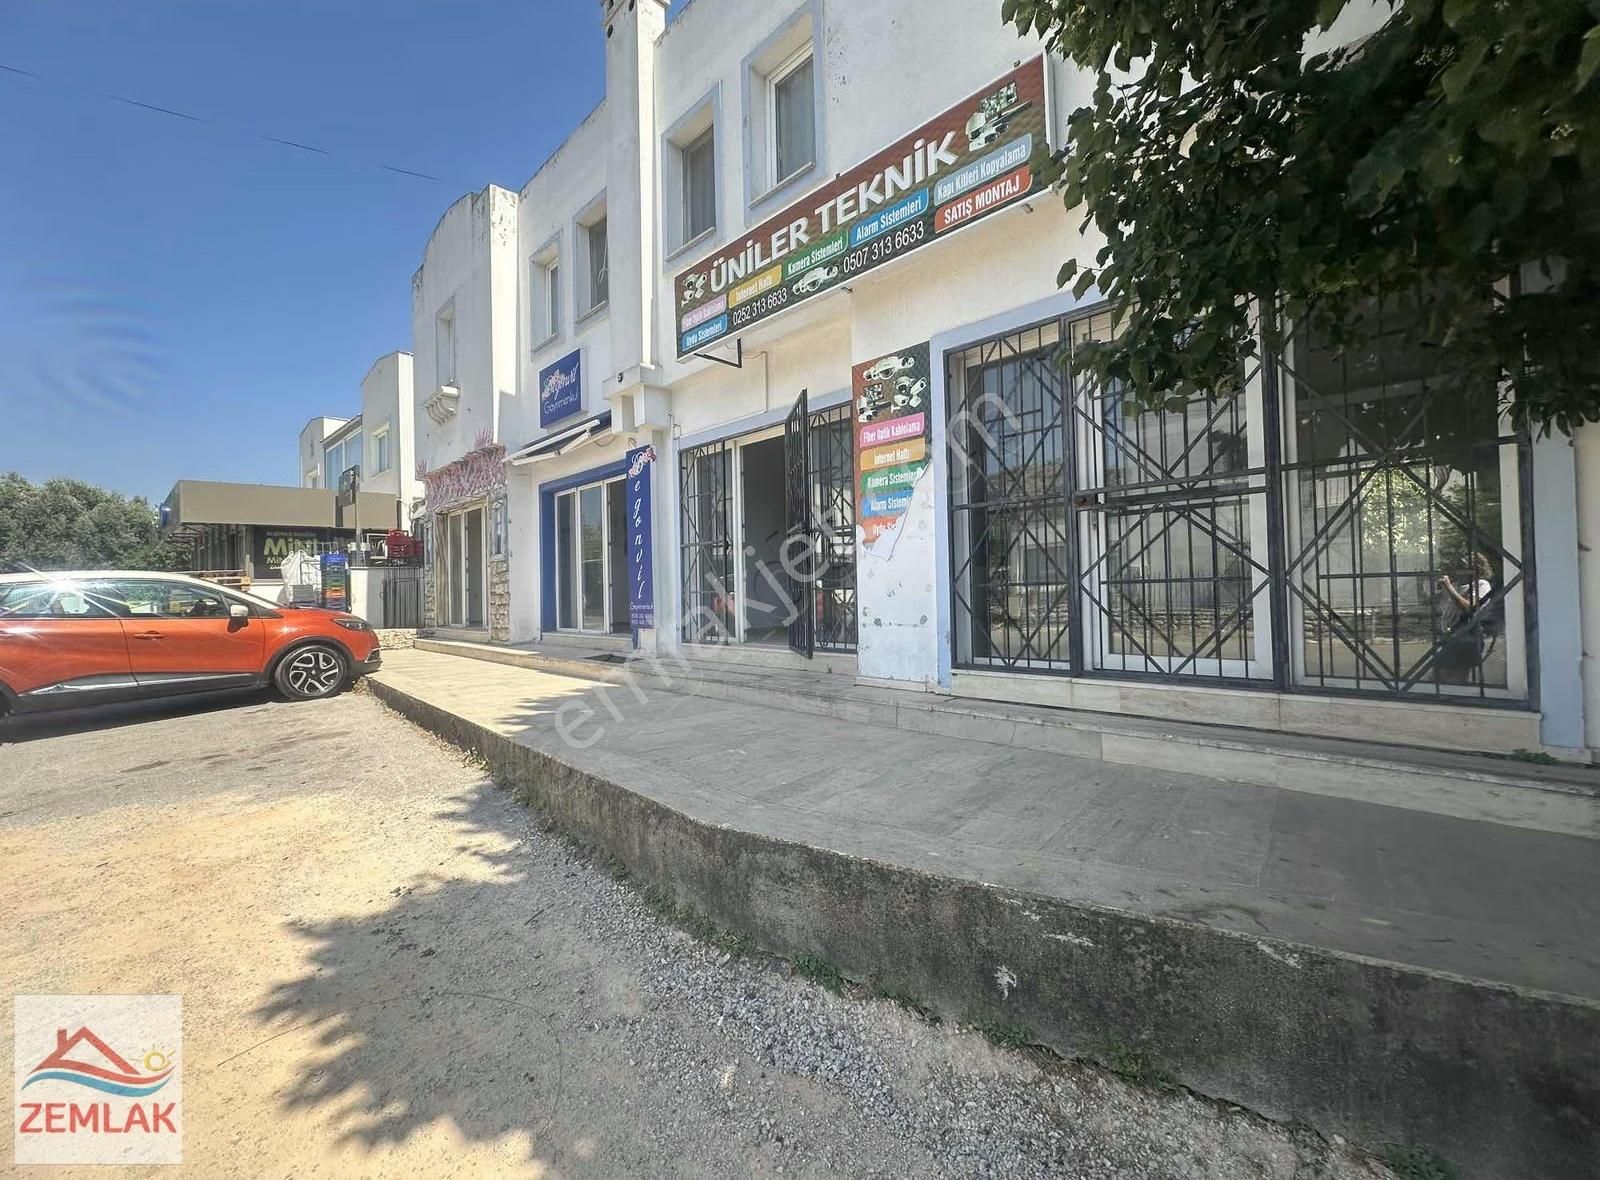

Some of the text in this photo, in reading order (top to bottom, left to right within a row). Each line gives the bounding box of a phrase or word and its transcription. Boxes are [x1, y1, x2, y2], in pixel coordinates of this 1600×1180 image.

[937, 181, 954, 200] Kapı
[980, 144, 1026, 178] Kopyalama
[710, 131, 959, 292] ÜNİLER TEKNİK
[856, 195, 922, 241] Alarm Sistemleri
[943, 174, 1020, 225] SATIŞ MONTAJ
[787, 236, 843, 276] Kamera Sistemleri
[843, 220, 924, 273] 0507 313 6633
[732, 287, 787, 325] 0252 313 6633
[863, 430, 877, 444] Fiber
[891, 421, 921, 438] Kablolama
[867, 475, 889, 488] Kamera
